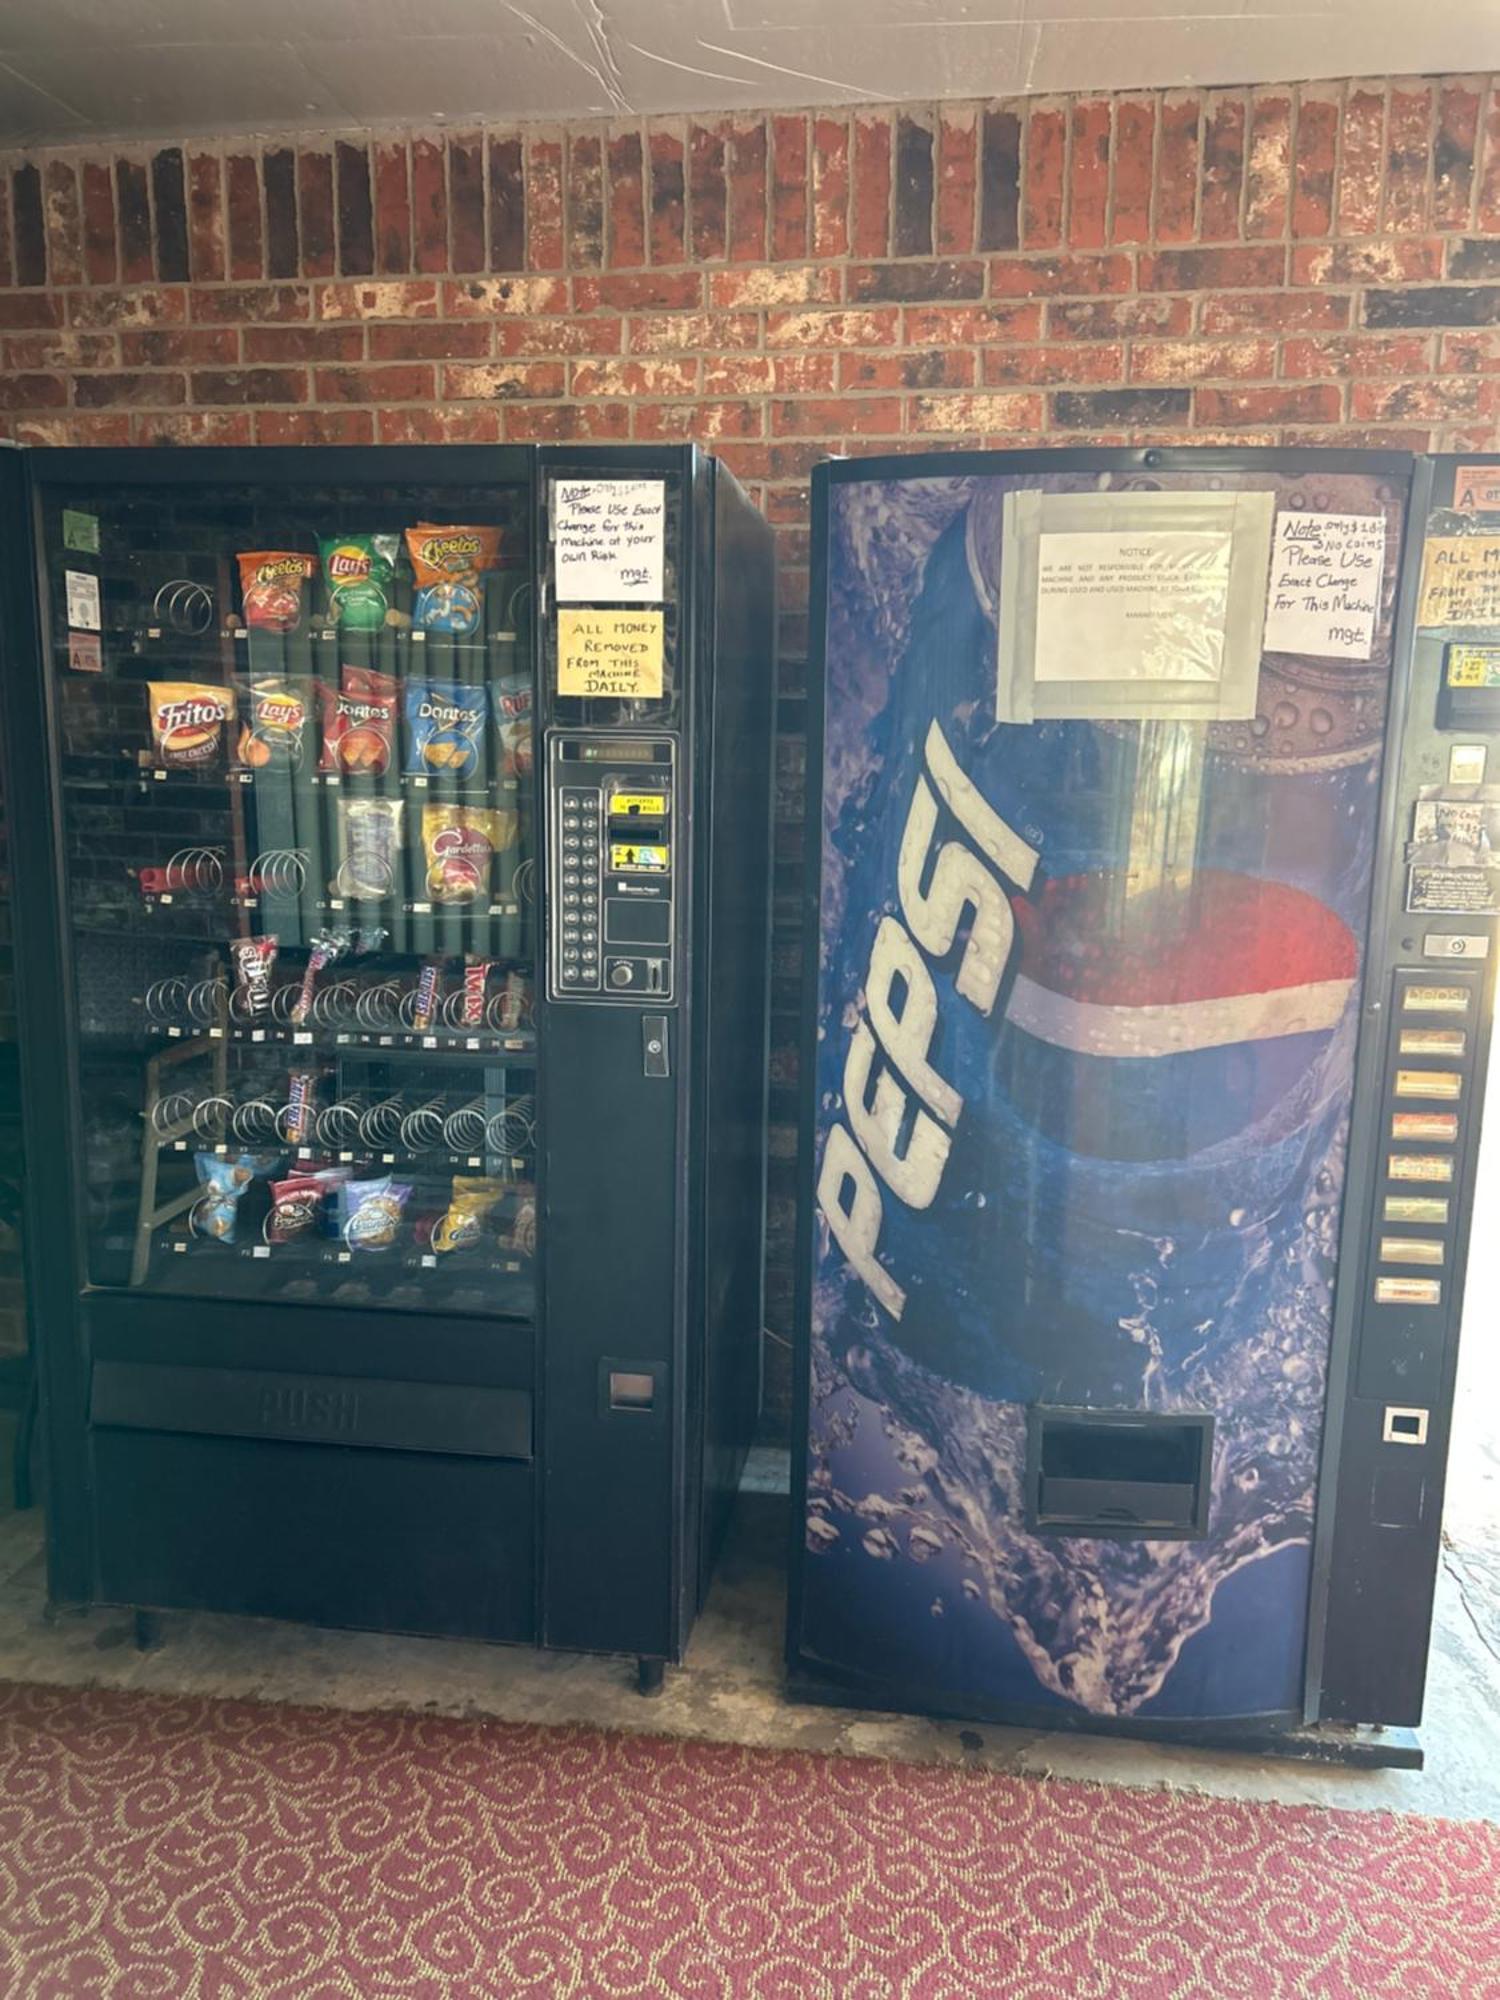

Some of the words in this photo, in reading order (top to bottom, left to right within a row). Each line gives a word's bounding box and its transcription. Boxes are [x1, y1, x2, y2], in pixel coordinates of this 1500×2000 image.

[1459, 489, 1475, 507] A
[569, 503, 601, 516] Please
[422, 535, 481, 564] Cheetos
[1120, 548, 1152, 557] NOTICE
[1282, 545, 1332, 567] Please
[1340, 552, 1373, 568] Use
[1434, 550, 1470, 564] ALL
[256, 557, 304, 585] Cheetos
[1278, 573, 1312, 588] Exact
[1316, 573, 1359, 591] Change
[1274, 593, 1296, 610] For
[1302, 596, 1329, 612] This
[1332, 594, 1375, 613] Machine
[572, 624, 602, 634] ALL
[614, 623, 656, 634] MONEY
[584, 640, 648, 653] REMOVED
[567, 656, 599, 669] FROM
[608, 659, 639, 668] THIS
[588, 669, 640, 679] MACHINE
[158, 704, 225, 732] Fritos
[419, 703, 477, 722] Doritos
[818, 718, 1040, 1322] PEPSI
[261, 1386, 360, 1432] PUSH
